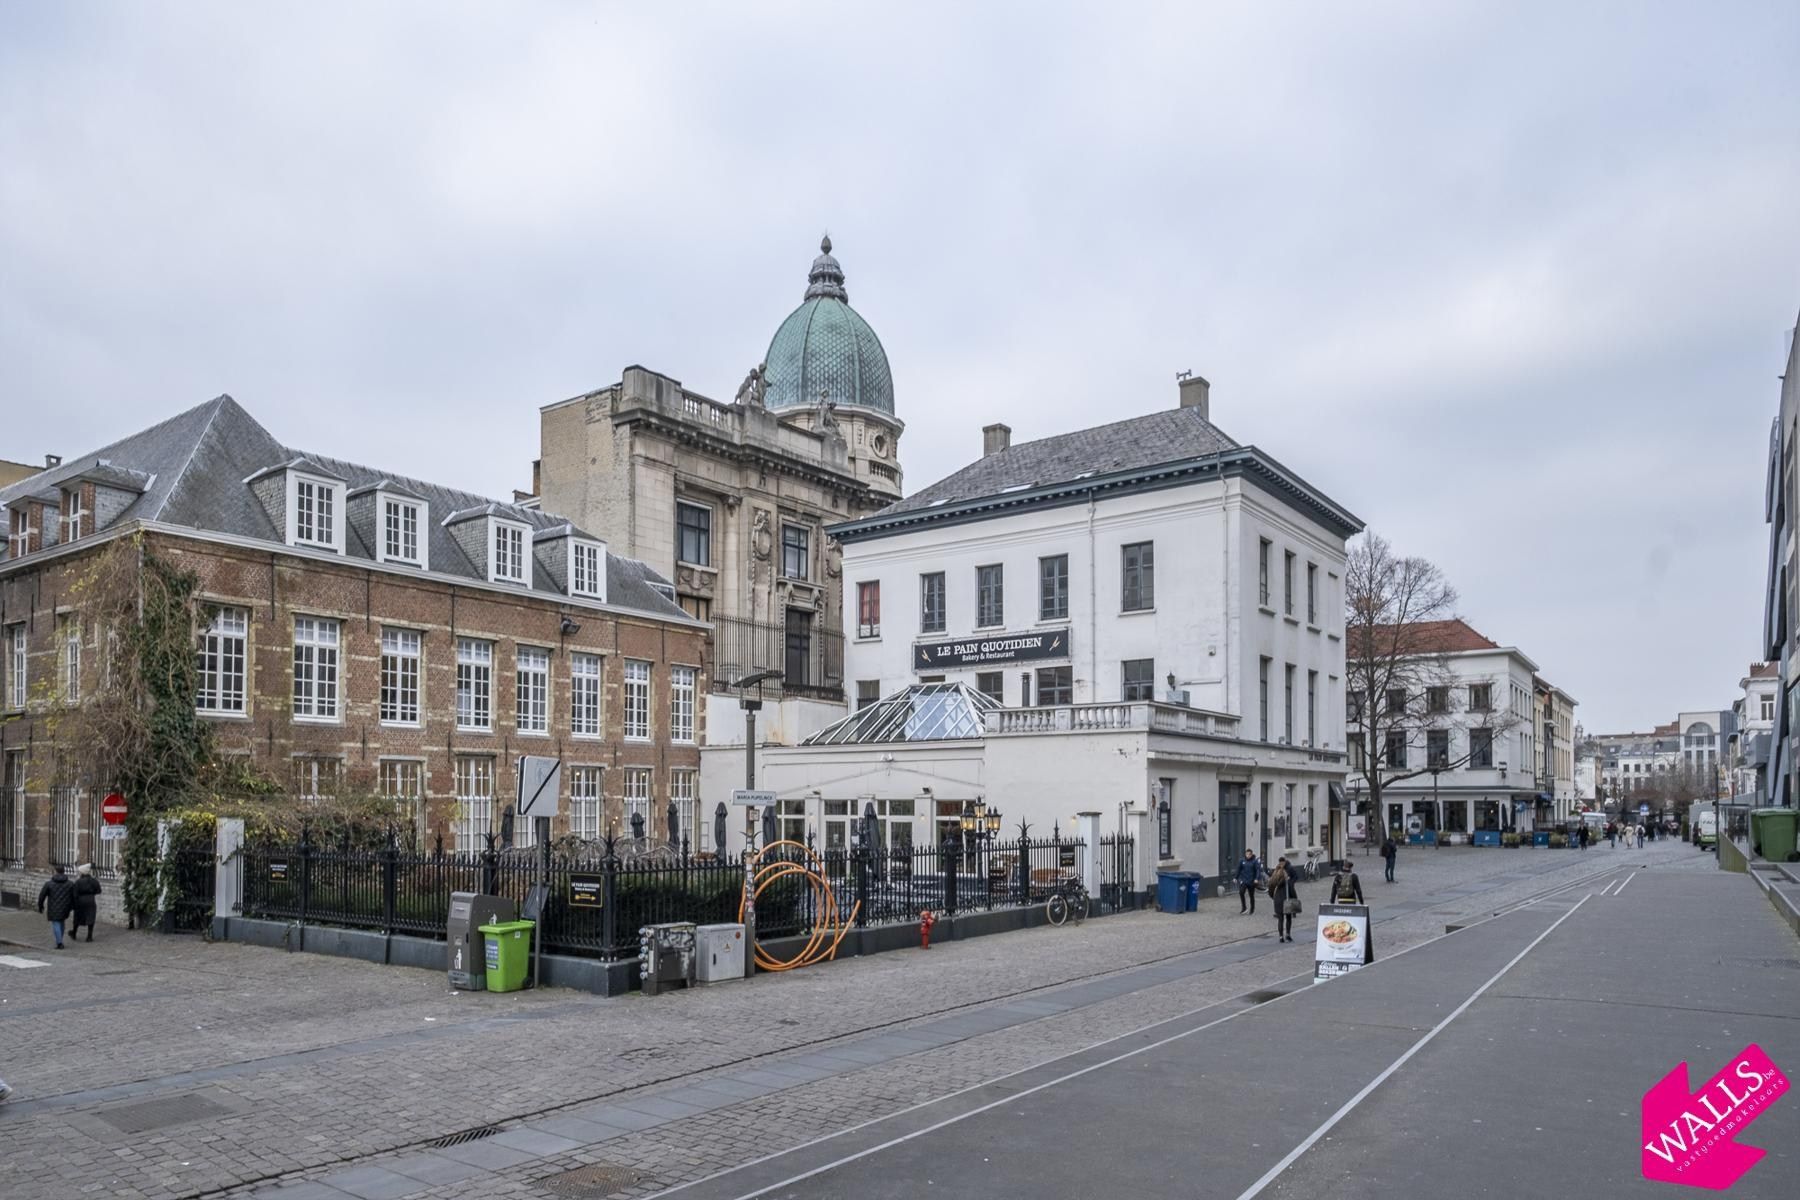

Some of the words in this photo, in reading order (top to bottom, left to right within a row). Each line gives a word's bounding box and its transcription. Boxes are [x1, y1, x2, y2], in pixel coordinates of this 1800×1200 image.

[937, 646, 951, 657] LE
[954, 643, 978, 655] PAIN
[981, 637, 1042, 652] QUOTIDIEN
[962, 654, 980, 662] Bakery
[986, 651, 1015, 659] Restaurant
